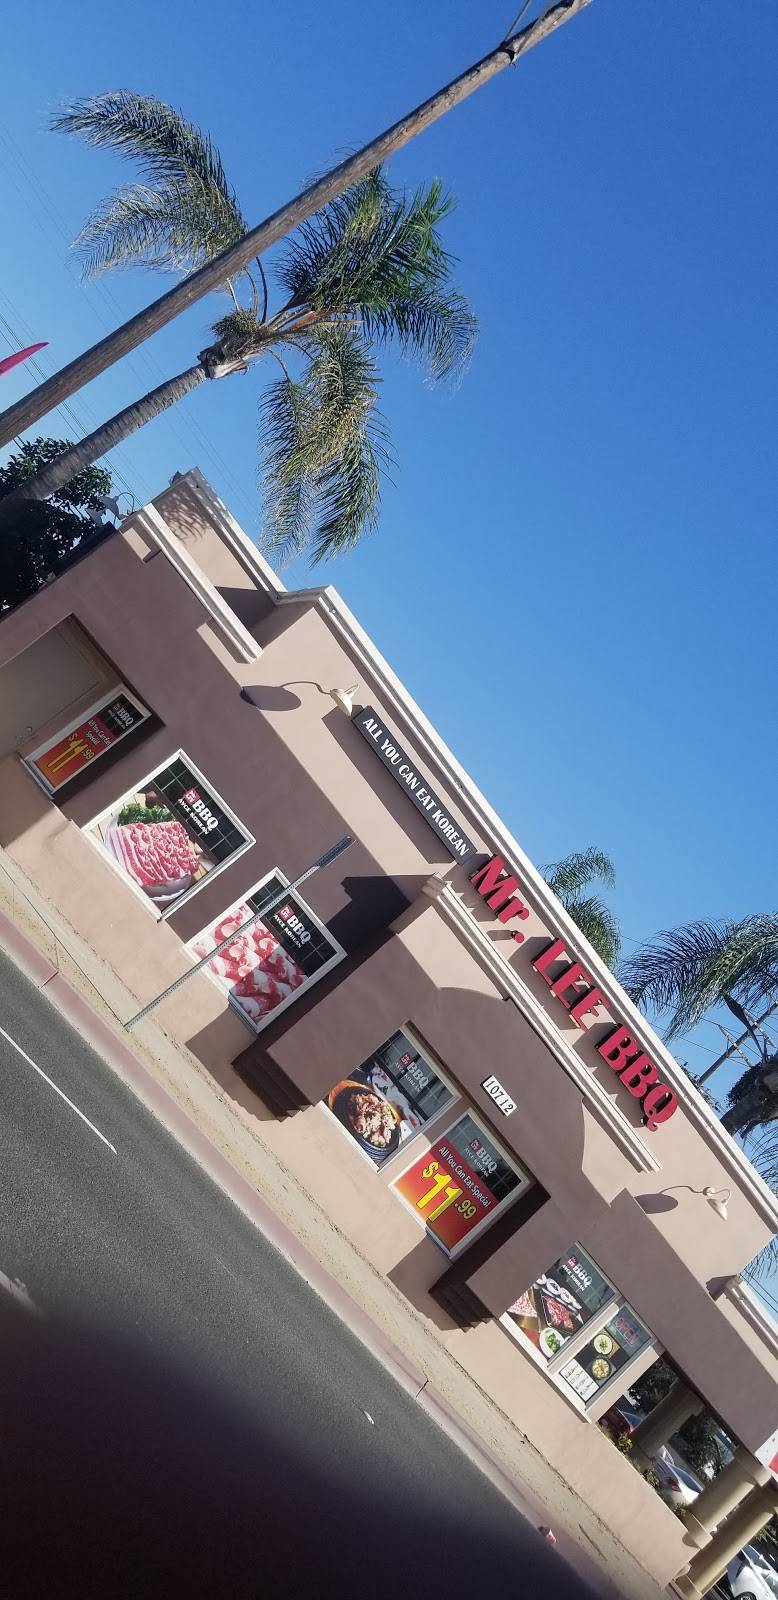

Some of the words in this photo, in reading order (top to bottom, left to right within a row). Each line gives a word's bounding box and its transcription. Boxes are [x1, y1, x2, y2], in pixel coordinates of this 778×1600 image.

[117, 708, 135, 728] BBQ
[363, 717, 384, 743] ALL
[378, 738, 403, 766] YOU
[397, 763, 421, 790] CAN
[415, 787, 437, 812] EAT
[431, 809, 470, 857] KOREAN
[190, 811, 209, 835] KOREAN
[192, 799, 220, 832] BBQ
[273, 914, 286, 928] AYCE
[284, 927, 302, 949] KOREAN
[286, 914, 313, 945] BBQ
[468, 854, 531, 944] Mr.
[531, 938, 613, 1033] LEE
[594, 1023, 680, 1132] BBQ
[406, 1061, 430, 1089] BBQ
[485, 1080, 515, 1113] 10712
[438, 1146, 450, 1158] All
[445, 1154, 458, 1168] You
[475, 1147, 499, 1174] BBQ
[454, 1164, 468, 1179] Can
[463, 1175, 476, 1188] Eat
[416, 1159, 478, 1222] $11.99
[469, 1184, 492, 1209] Special
[572, 1263, 594, 1288] BBQ
